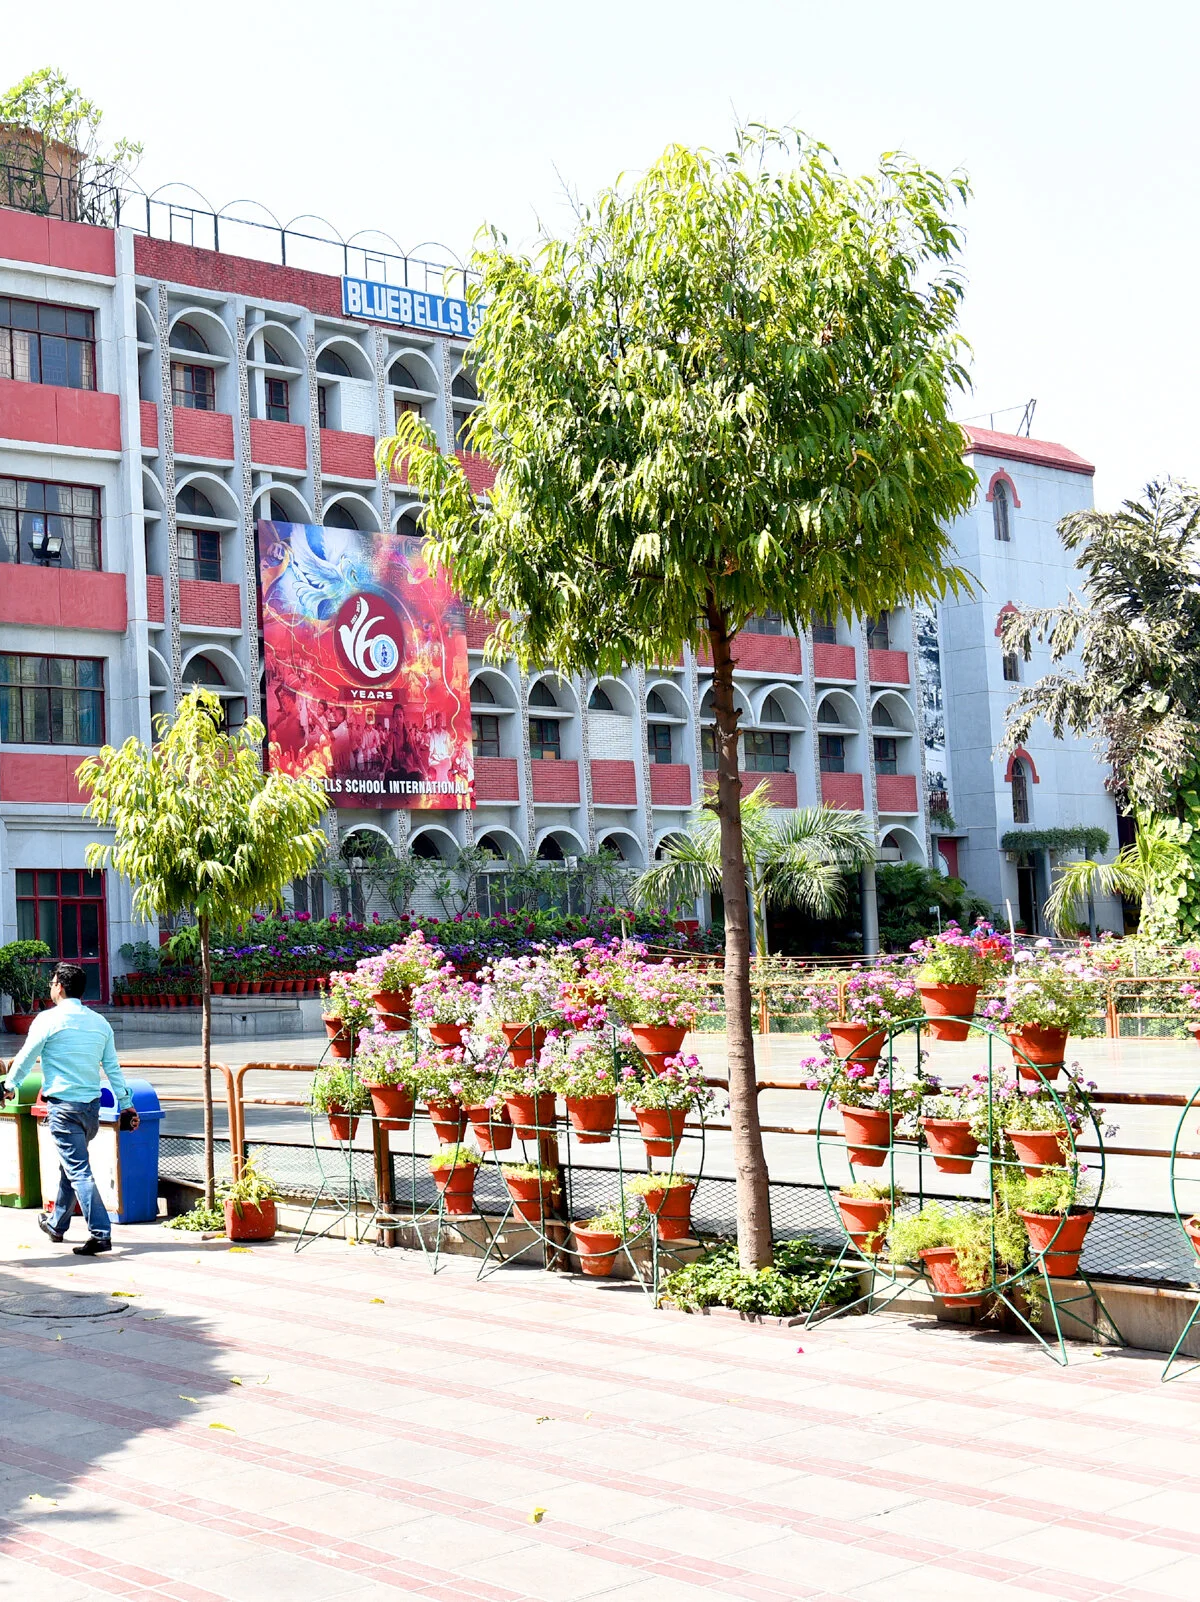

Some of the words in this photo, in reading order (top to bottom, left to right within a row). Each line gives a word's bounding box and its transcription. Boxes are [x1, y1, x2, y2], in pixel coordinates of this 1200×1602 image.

[347, 280, 462, 332] BLUEBELLS
[350, 689, 393, 700] YEARS
[345, 779, 386, 794] SCHOOL
[389, 780, 467, 794] INTERNATIONAL
